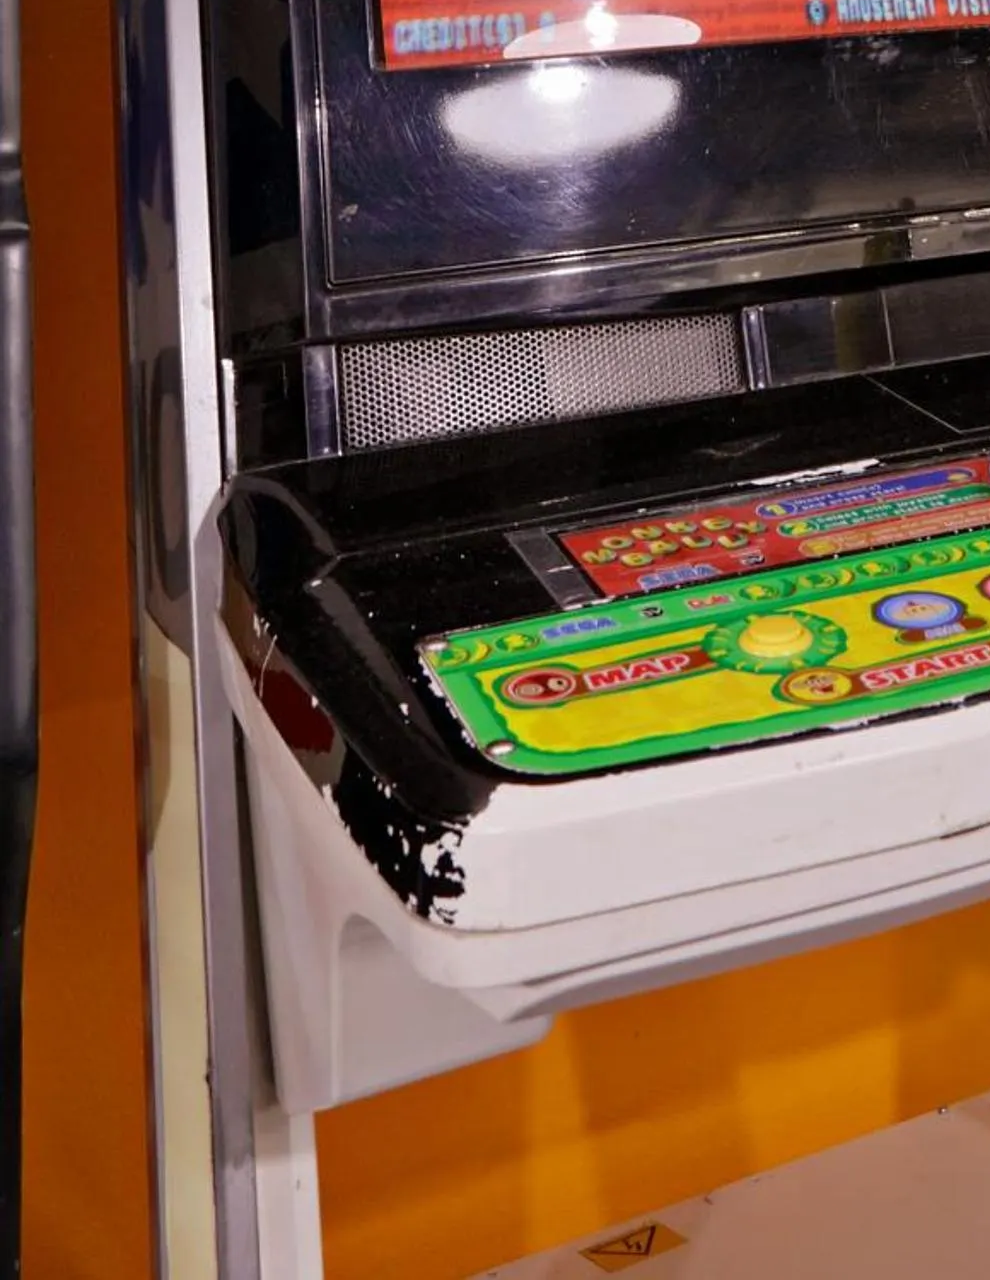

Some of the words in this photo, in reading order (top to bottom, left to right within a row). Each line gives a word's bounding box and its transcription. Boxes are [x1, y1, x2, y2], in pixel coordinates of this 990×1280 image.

[581, 517, 767, 565] MONKEY
[619, 533, 749, 567] BALL
[637, 564, 720, 590] SEGA
[542, 617, 617, 639] SEGA
[584, 653, 690, 691] MAP
